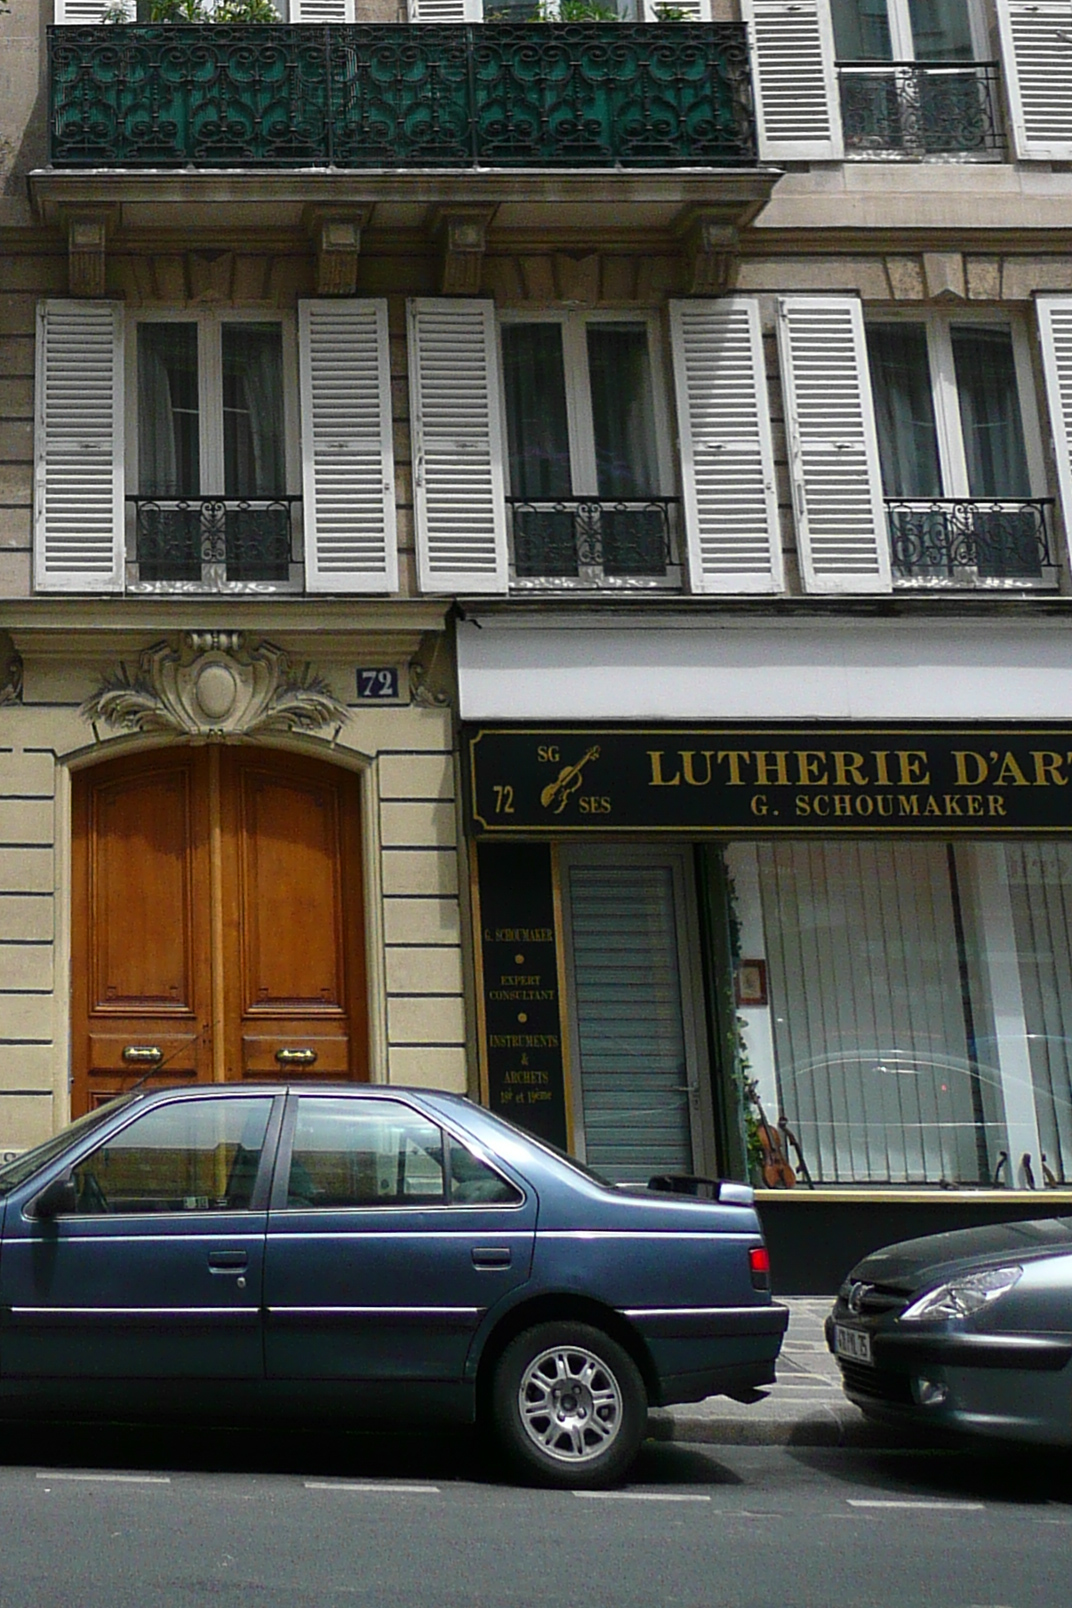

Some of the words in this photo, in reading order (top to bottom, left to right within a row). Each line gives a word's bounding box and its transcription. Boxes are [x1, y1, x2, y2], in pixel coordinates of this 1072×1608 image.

[361, 670, 394, 695] 72
[537, 746, 560, 762] SG
[645, 750, 930, 786] LUTHERIE
[950, 750, 1072, 786] D'AR
[493, 786, 515, 814] 72
[579, 797, 611, 813] SES
[750, 794, 779, 816] G.
[795, 794, 1007, 816] SCHOUMAKER
[501, 975, 541, 986] EXPERT
[489, 990, 555, 1000] CONSULTANT
[489, 1034, 559, 1048] INSTRUMENTS
[504, 1071, 549, 1084] ARCHETS
